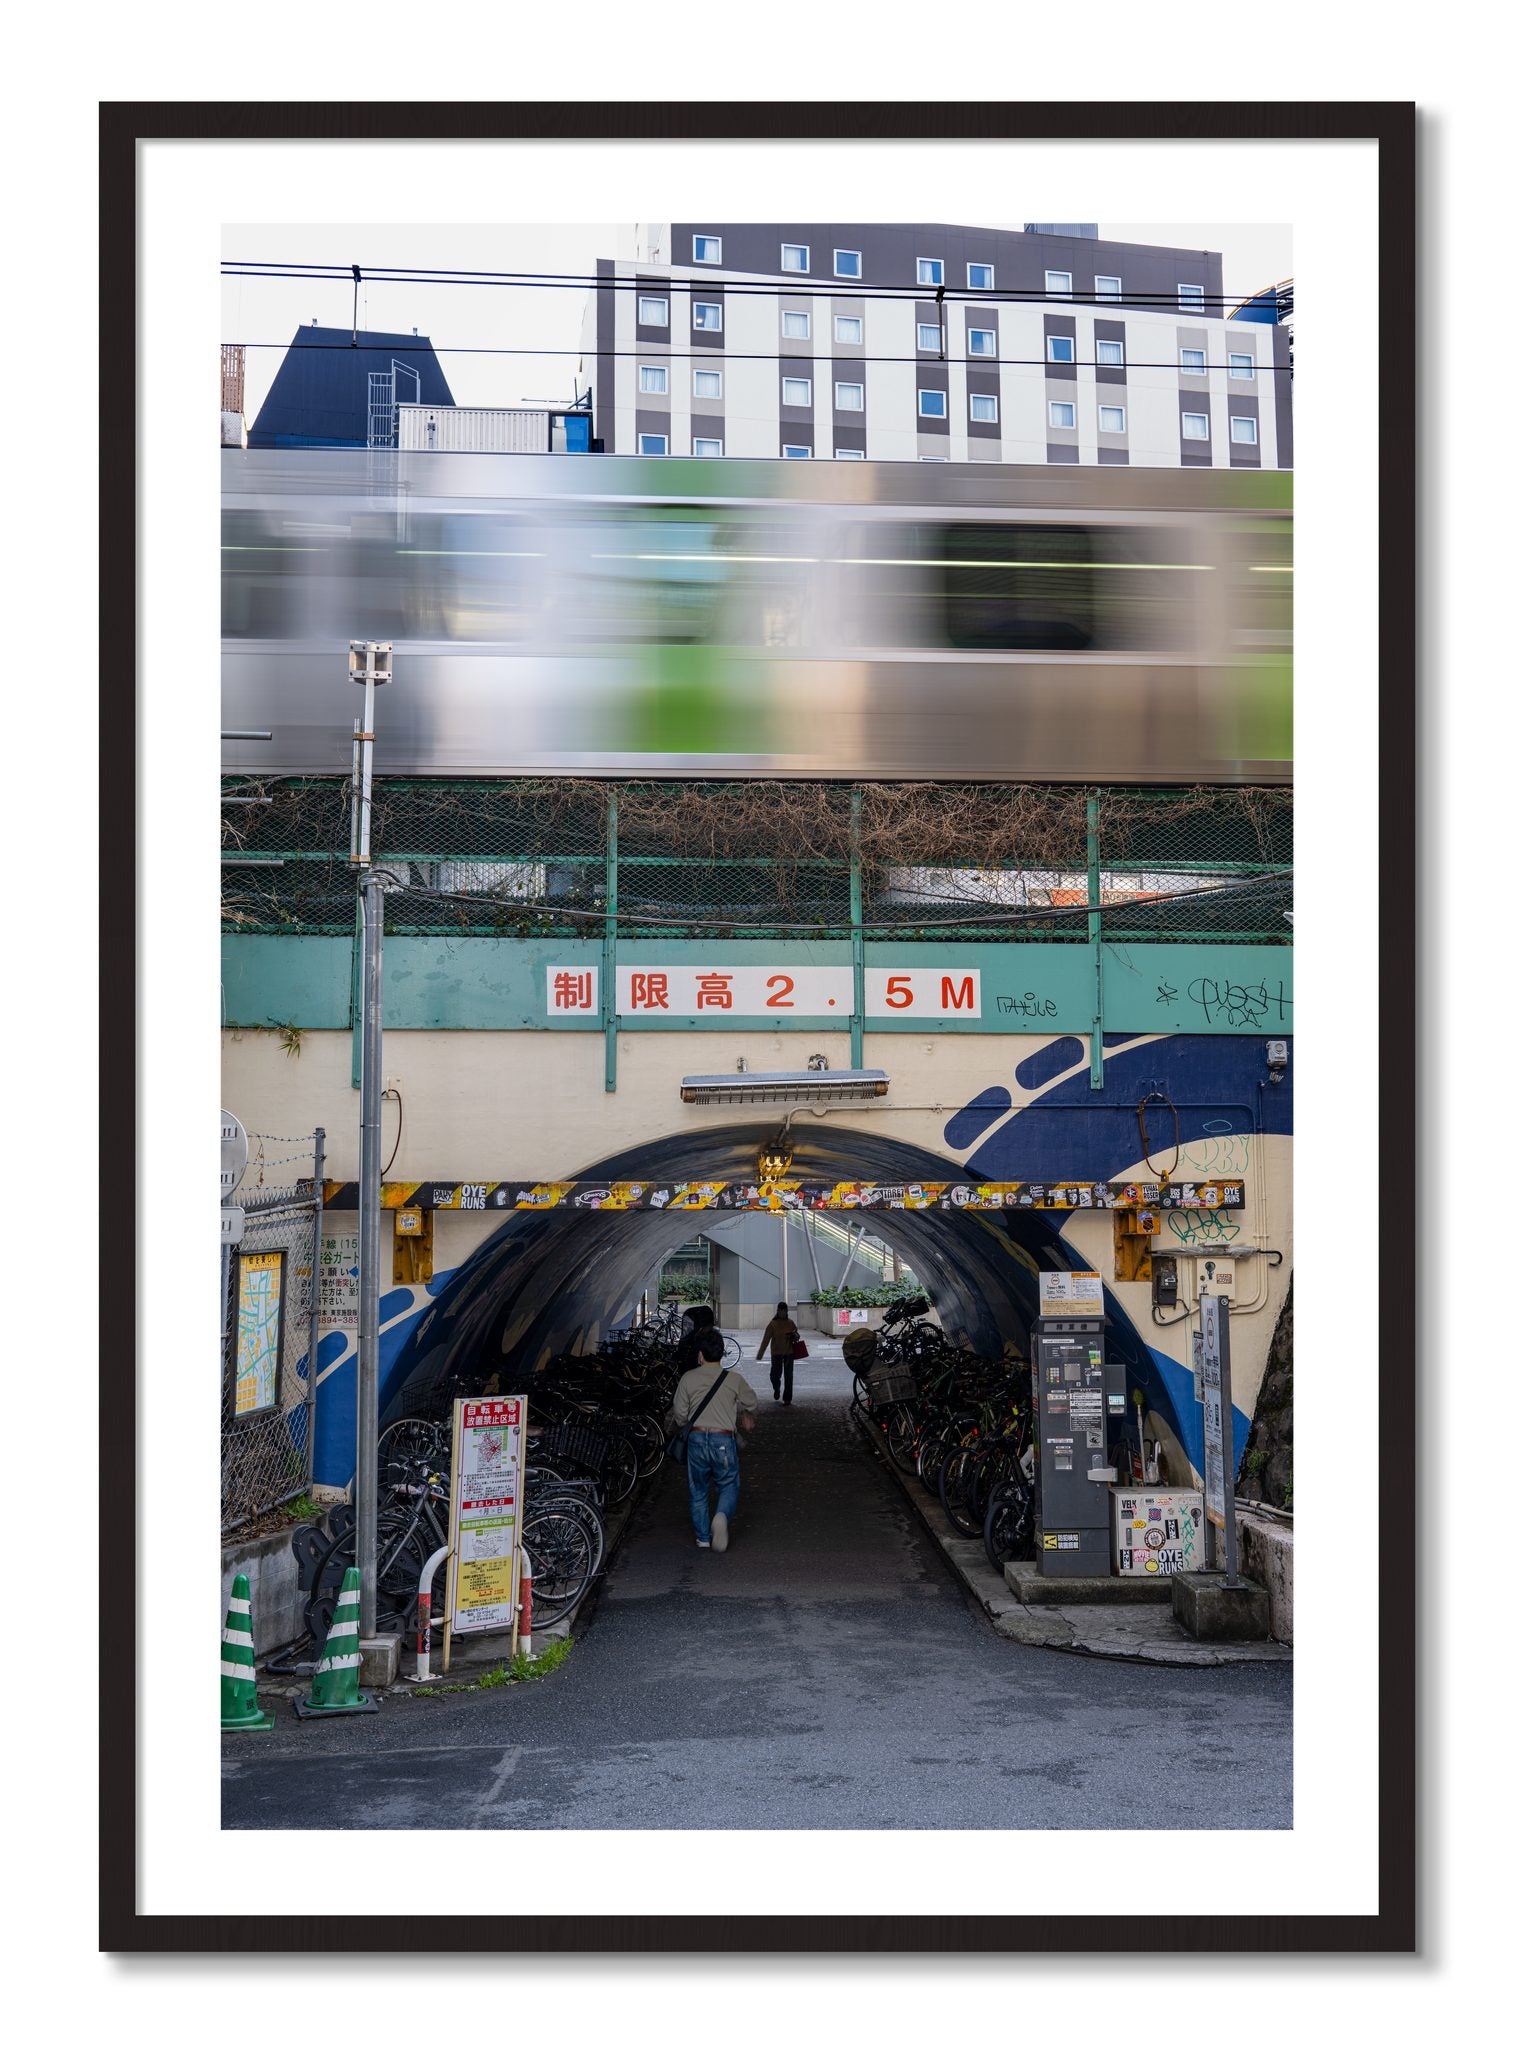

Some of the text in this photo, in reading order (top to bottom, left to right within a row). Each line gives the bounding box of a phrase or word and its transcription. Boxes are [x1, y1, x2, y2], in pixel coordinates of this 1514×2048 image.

[462, 1185, 486, 1197] OYE
[1224, 1187, 1240, 1195] OYE
[461, 1197, 486, 1209] RUNS
[1224, 1195, 1240, 1204] RUNS
[467, 1402, 517, 1415] 自転車等
[466, 1414, 517, 1426] 放置禁止区域
[1158, 1549, 1183, 1561] OYE
[1159, 1561, 1184, 1575] RUNS
